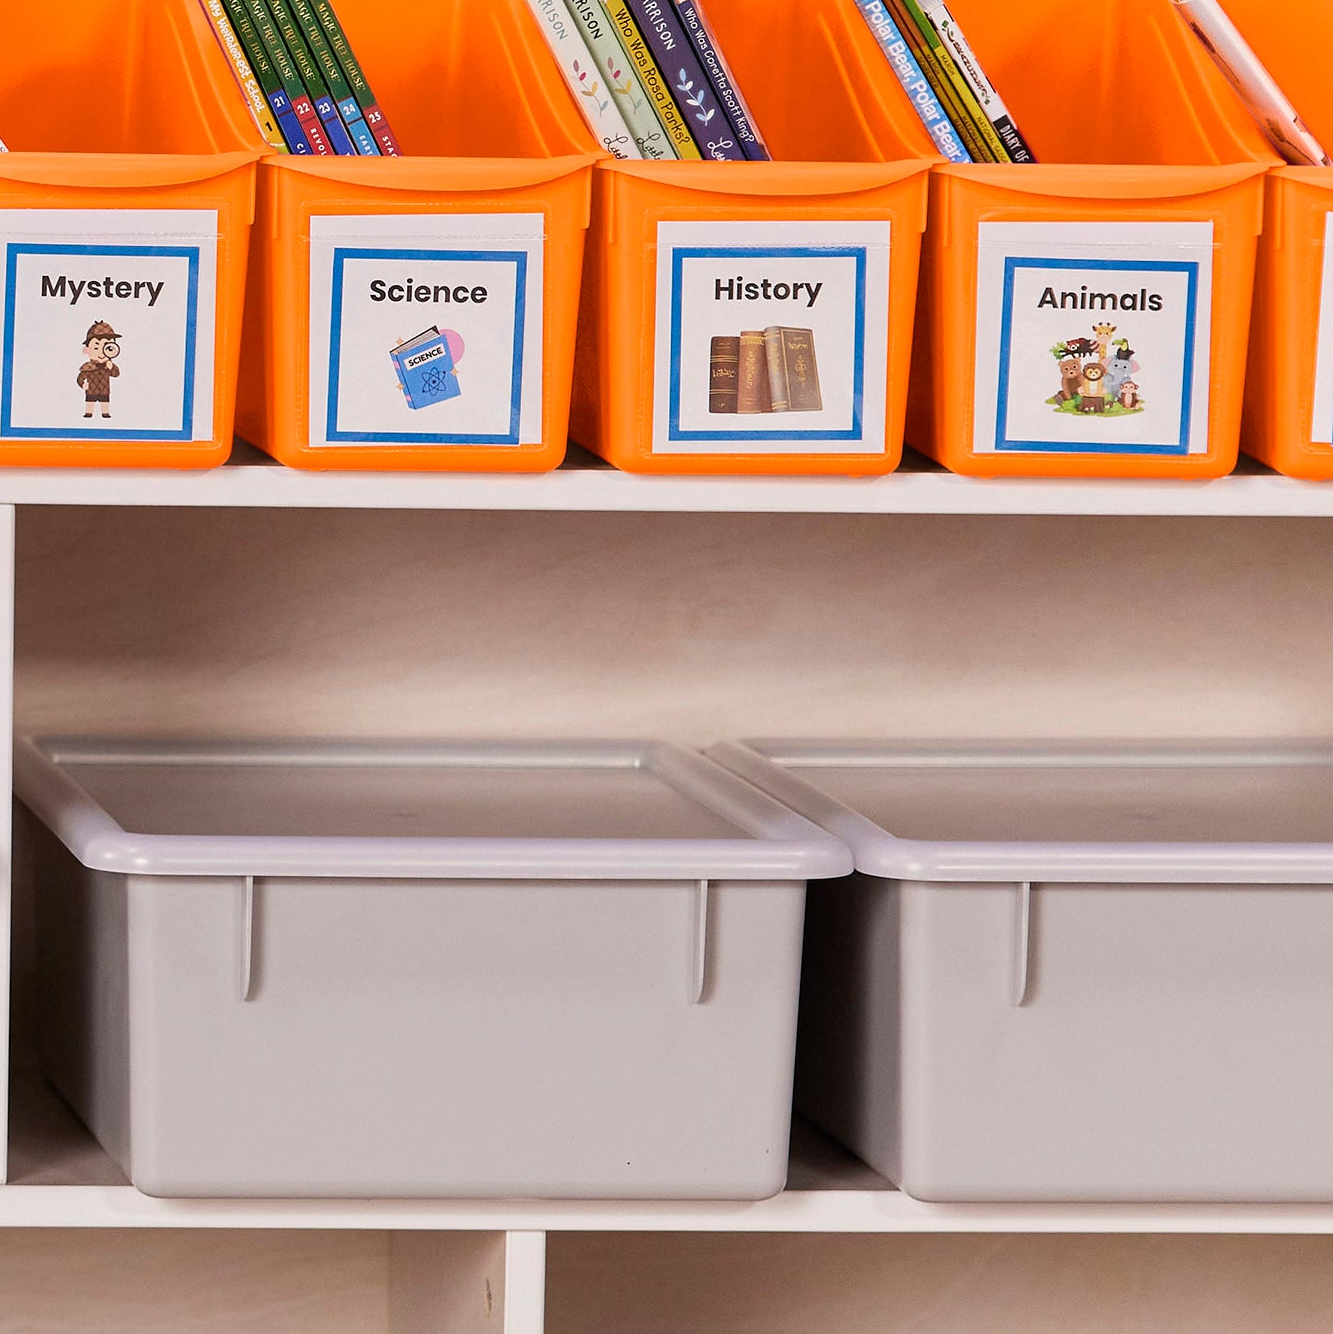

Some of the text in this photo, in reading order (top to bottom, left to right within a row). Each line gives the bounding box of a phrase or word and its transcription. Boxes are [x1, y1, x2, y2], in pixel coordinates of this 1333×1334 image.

[208, 0, 222, 17] My
[239, 17, 254, 40] TREE
[263, 23, 277, 47] TREE
[283, 23, 298, 46] TREE
[308, 25, 324, 48] TREE
[317, 2, 337, 34] MAGIC
[333, 34, 349, 57] TREE
[865, 0, 895, 41] Polar
[888, 40, 917, 83] Bear,
[910, 80, 940, 121] Polar
[615, 8, 691, 145] Who Was Rosa Parks?
[685, 7, 755, 143] Who Was Coretta Scott King?
[274, 96, 285, 108] 21
[297, 102, 310, 115] 22
[318, 102, 331, 115] 23
[342, 103, 355, 116] 24
[265, 121, 273, 132] 1
[368, 111, 381, 124] 25
[999, 124, 1030, 162] DIARY OF
[40, 275, 164, 307] Mystery
[369, 278, 488, 304] Science
[714, 276, 823, 307] History
[1037, 285, 1164, 312] Animals
[408, 347, 443, 367] SCIENCE
